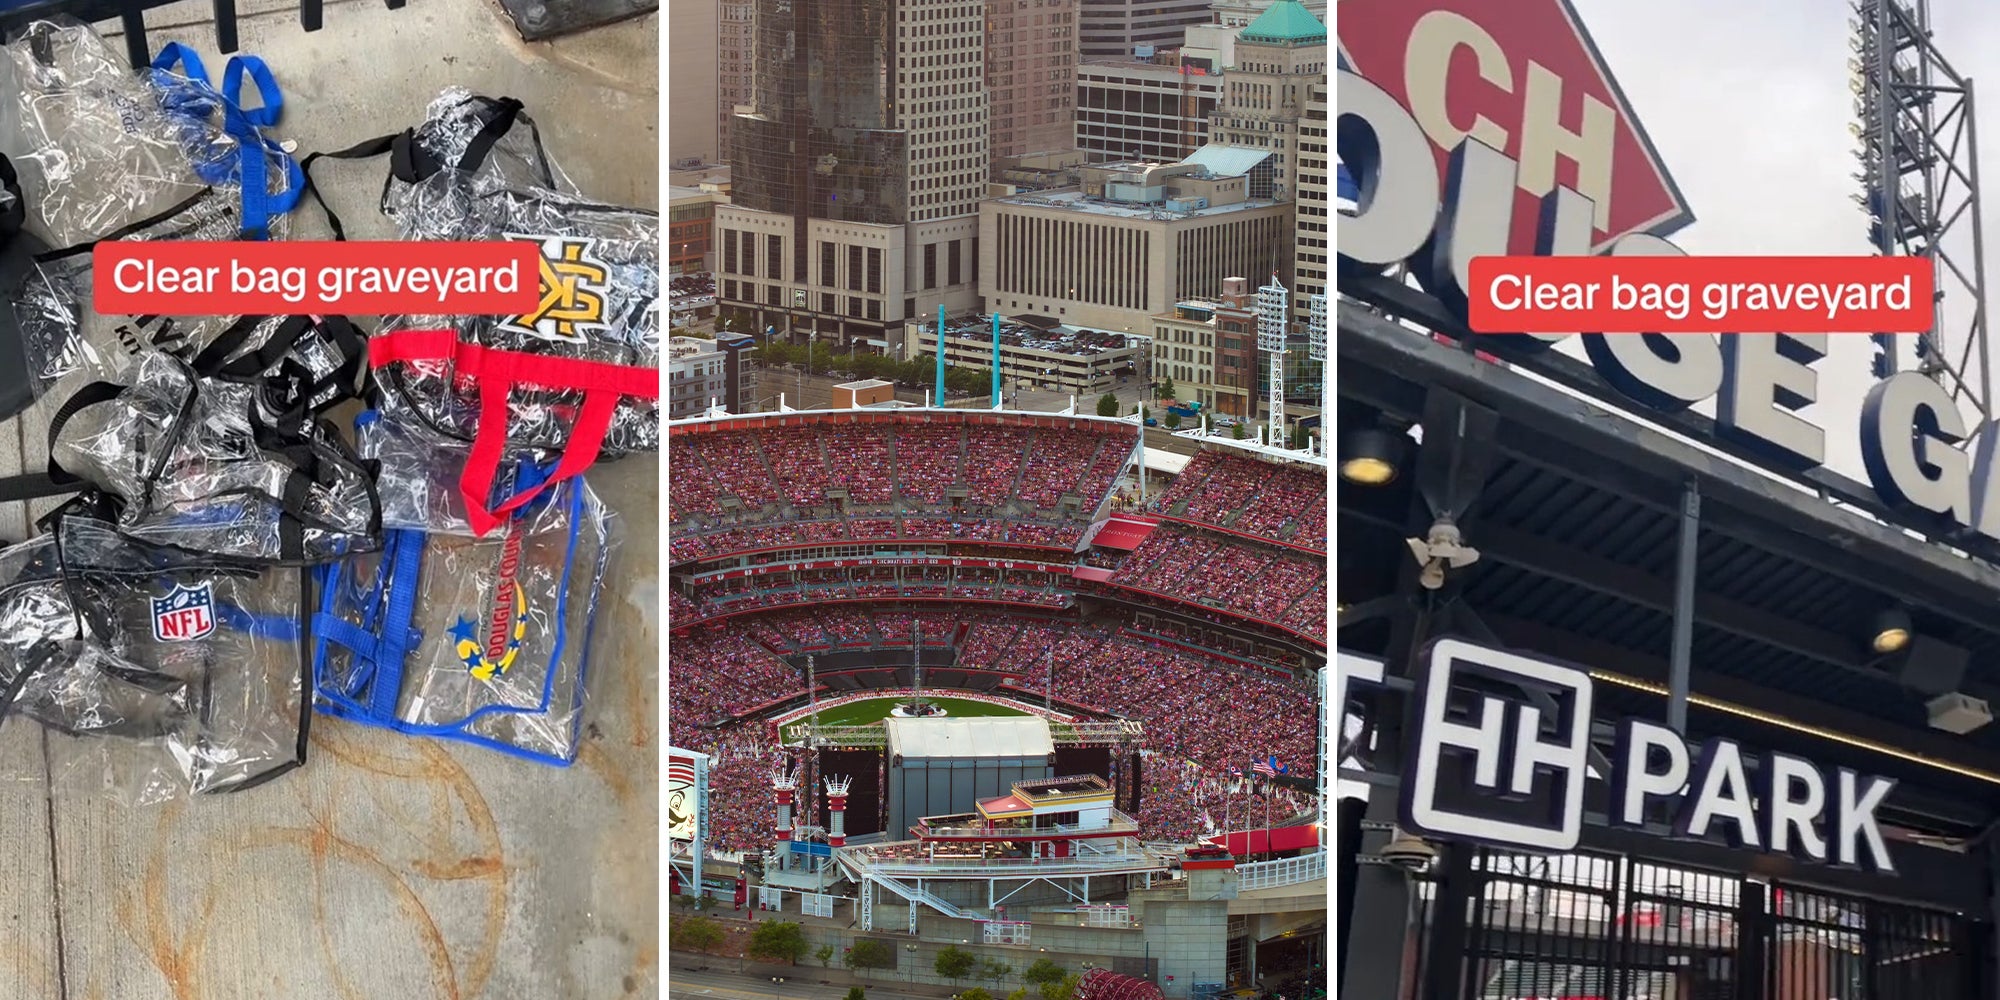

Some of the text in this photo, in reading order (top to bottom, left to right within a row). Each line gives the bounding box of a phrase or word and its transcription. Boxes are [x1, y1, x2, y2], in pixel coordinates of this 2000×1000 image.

[160, 608, 210, 638] NFL
[488, 581, 514, 658] DOUGLAS
[1622, 720, 1898, 873] PARK
